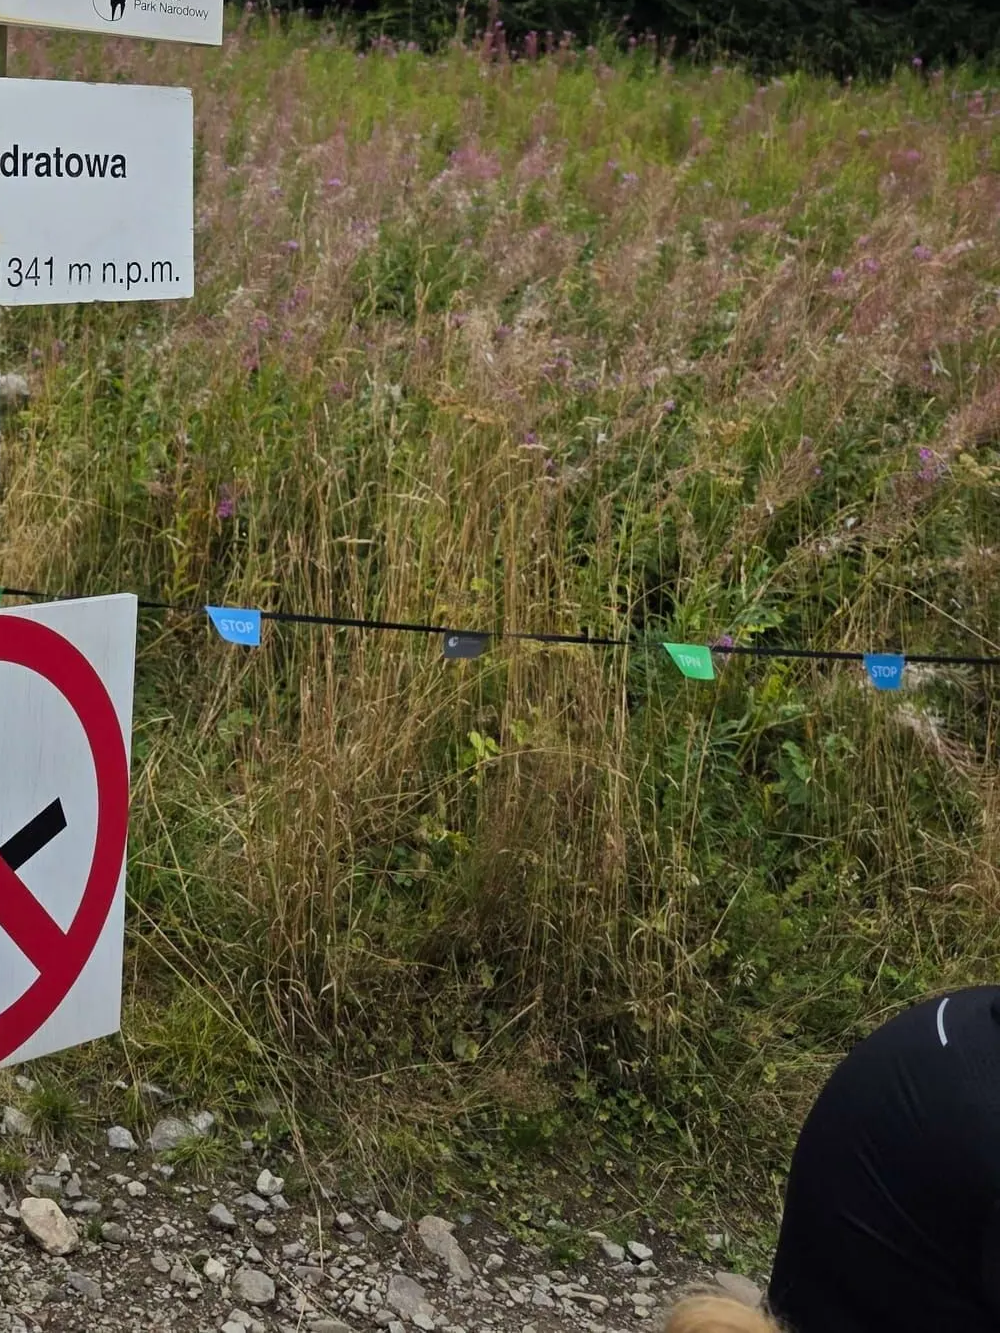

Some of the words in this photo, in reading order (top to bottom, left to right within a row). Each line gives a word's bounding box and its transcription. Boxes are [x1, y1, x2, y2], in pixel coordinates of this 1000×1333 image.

[159, 2, 209, 20] Narodowy
[68, 262, 91, 285] m
[102, 260, 180, 291] n.p.m.
[220, 618, 254, 634] STOP
[871, 665, 898, 678] STOP
